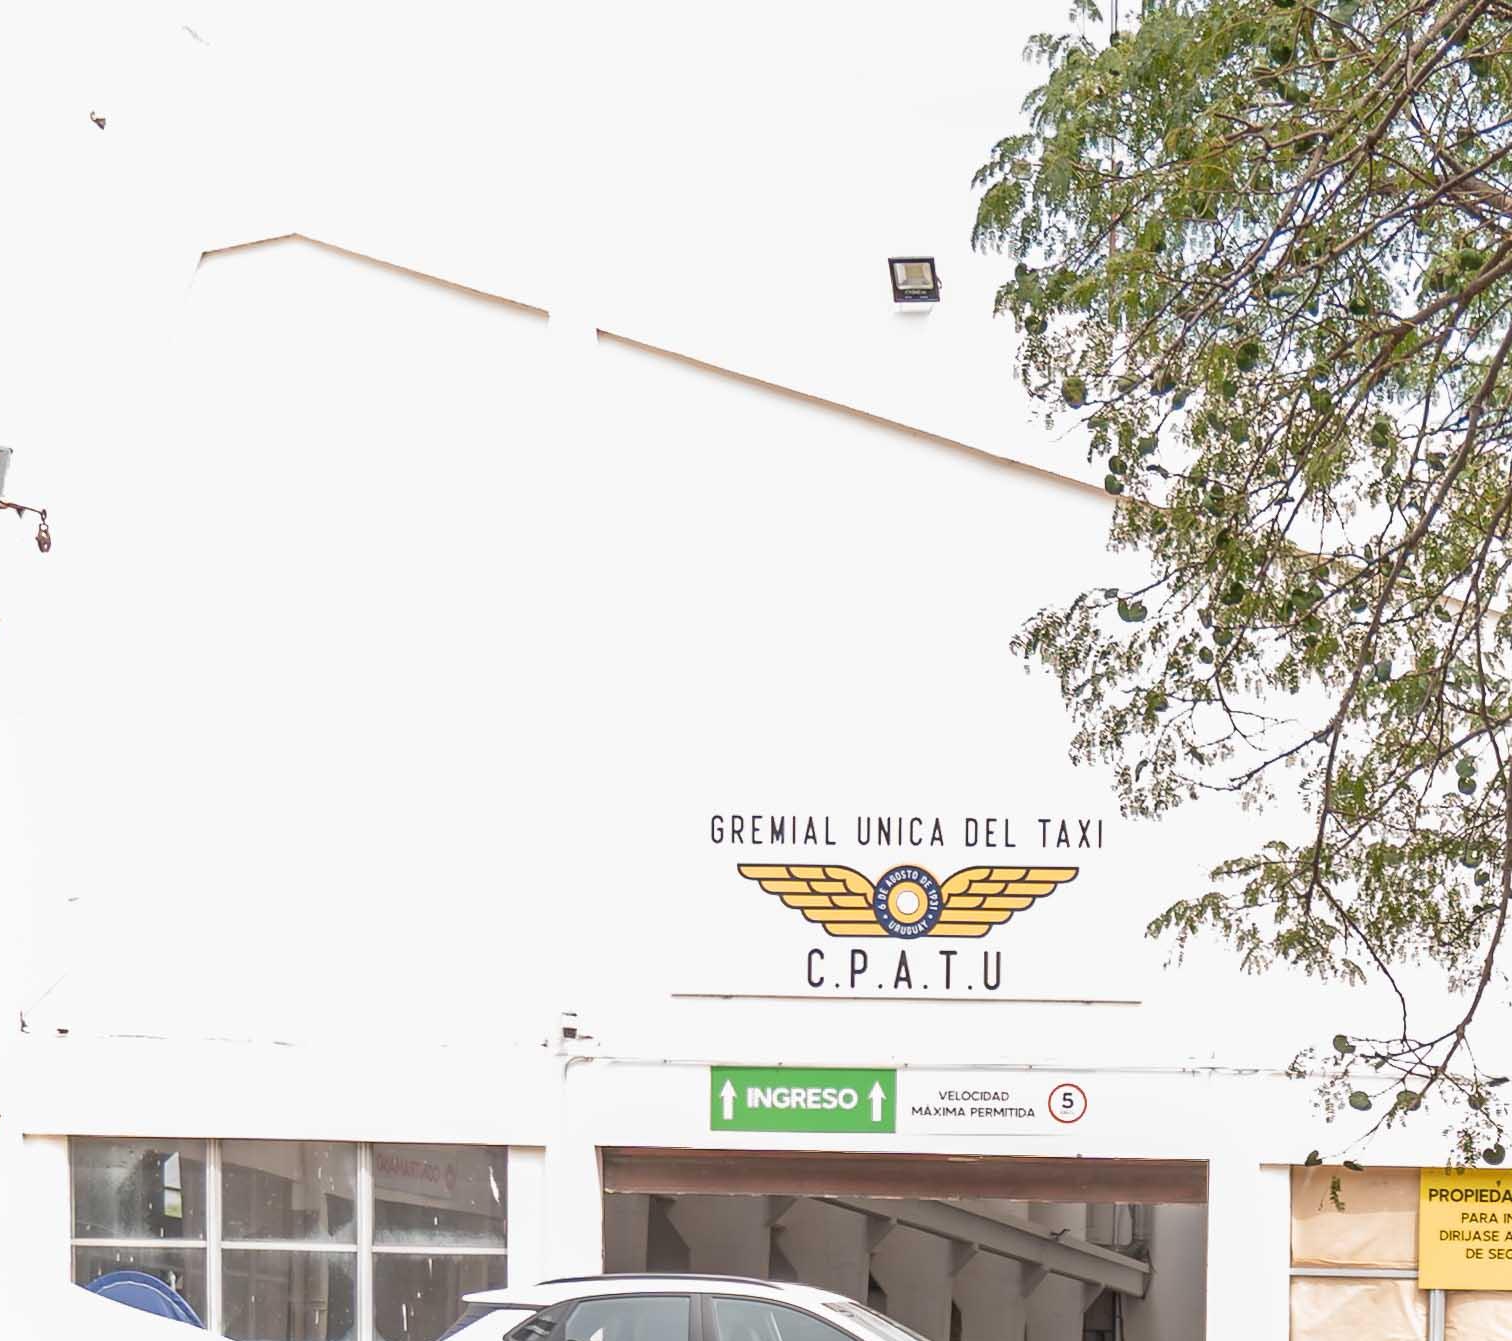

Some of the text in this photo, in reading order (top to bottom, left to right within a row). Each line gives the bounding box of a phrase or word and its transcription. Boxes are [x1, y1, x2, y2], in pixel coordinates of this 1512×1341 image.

[710, 815, 1103, 848] GREMIAL UNICA DEL TAXI
[885, 870, 919, 887] AGOSTO
[920, 876, 933, 889] DE
[888, 920, 928, 935] URUGUAY
[807, 948, 1001, 990] C.P.A.T.U
[747, 1087, 858, 1110] INGRESO
[938, 1090, 1010, 1102] VELOCIDAD
[1061, 1092, 1074, 1108] 5
[911, 1104, 1036, 1118] MÁXIMA PERMITIDA
[1461, 1212, 1498, 1224] PARA
[1439, 1230, 1500, 1242] DIRIJASE
[1466, 1248, 1484, 1260] DE
